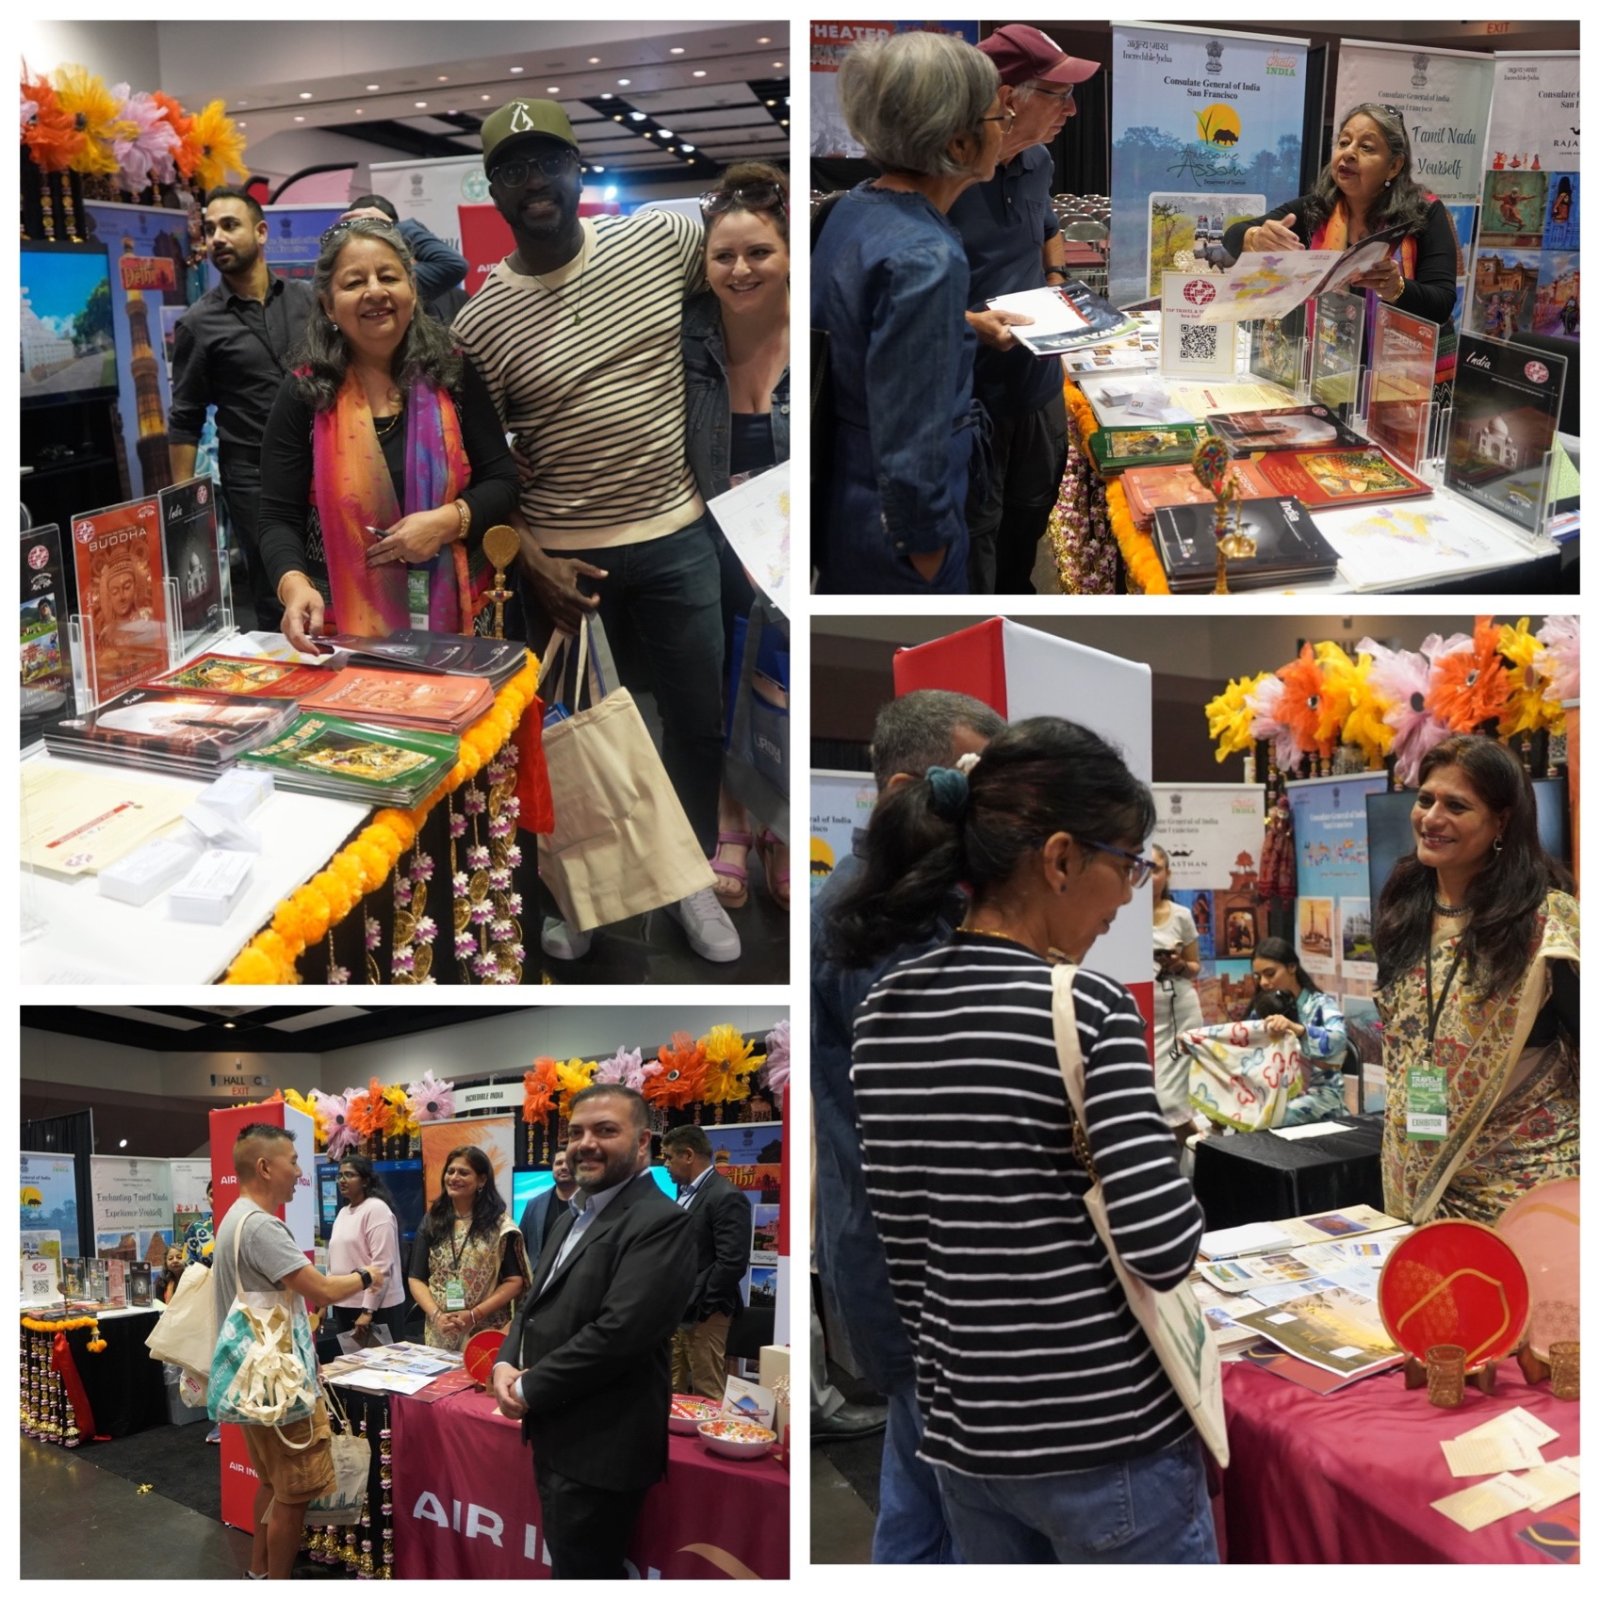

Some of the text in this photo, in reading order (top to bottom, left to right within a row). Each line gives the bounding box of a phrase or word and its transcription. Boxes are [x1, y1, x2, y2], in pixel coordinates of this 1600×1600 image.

[1487, 22, 1510, 33] EXIT
[1266, 67, 1296, 77] INDIA
[1164, 76, 1261, 92] Consulate General of India
[1187, 88, 1238, 100] San Francisco
[1378, 90, 1406, 99] Consulate
[1407, 92, 1428, 101] General
[1436, 94, 1450, 102] India
[1538, 90, 1575, 98] Consulate
[1412, 125, 1477, 145] Tamil Nadu
[1167, 150, 1246, 187] Assam
[1417, 158, 1464, 180] Yourself
[1466, 351, 1492, 369] India
[1280, 501, 1300, 522] India
[89, 527, 147, 552] BUDDHA
[832, 816, 852, 824] India
[223, 1076, 245, 1086] HALL
[232, 1087, 249, 1096] EXIT
[465, 1091, 504, 1102] INCREDIBLE INDIA
[1412, 1118, 1442, 1127] EXHIBITOR
[220, 1176, 237, 1184] AIR
[96, 1192, 169, 1203] Enchanting Tamil Nadu
[105, 1208, 163, 1218] Experience Yourself
[229, 1462, 244, 1473] AIR
[413, 1491, 504, 1548] AIR
